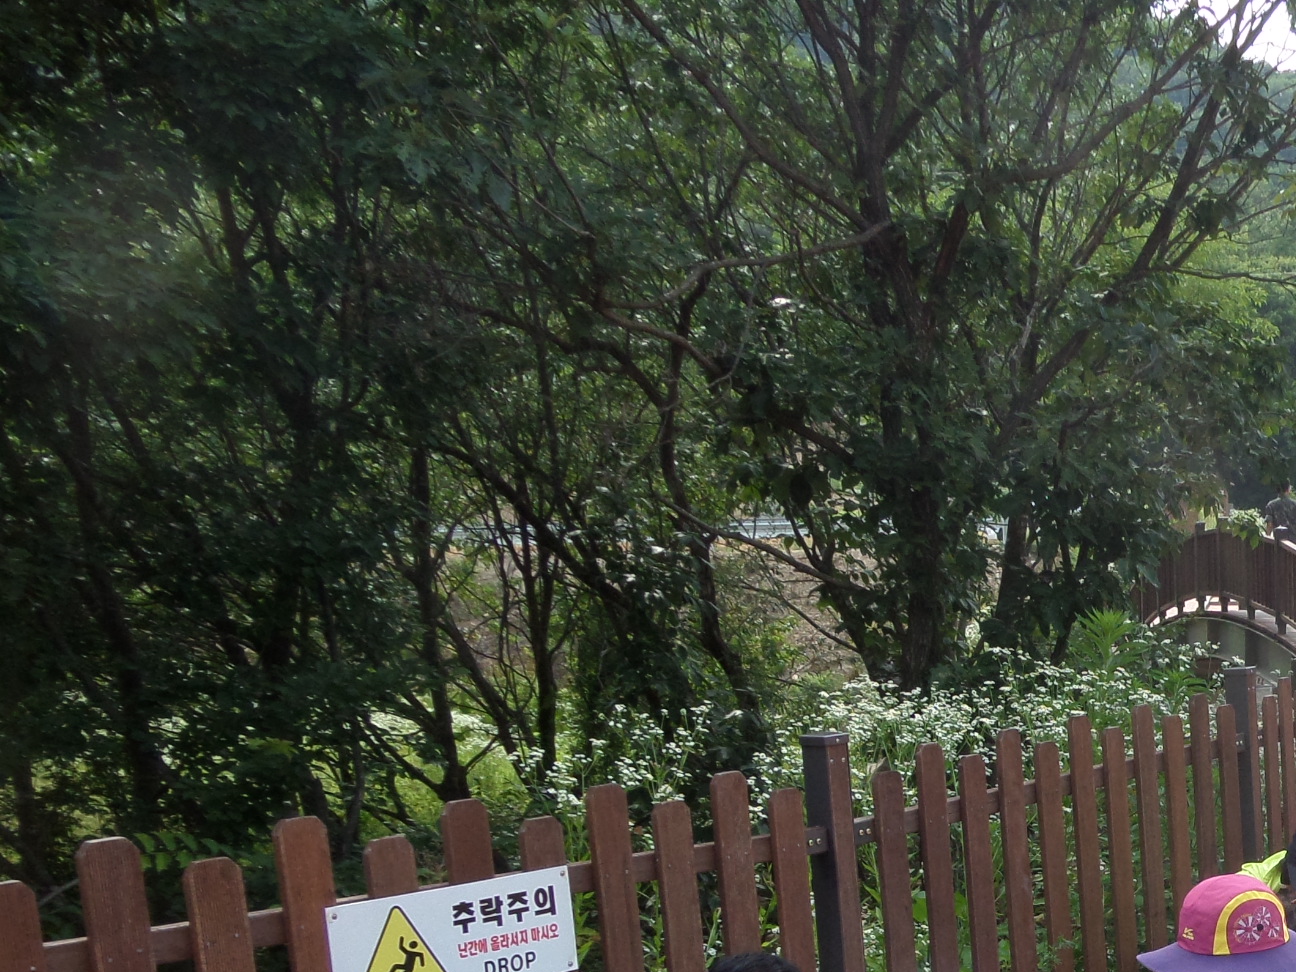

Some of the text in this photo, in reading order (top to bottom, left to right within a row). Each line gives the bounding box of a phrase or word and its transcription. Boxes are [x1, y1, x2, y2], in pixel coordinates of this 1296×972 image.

[452, 885, 557, 934] 추락주의
[457, 923, 559, 958] 난간에 올라서지 마시오
